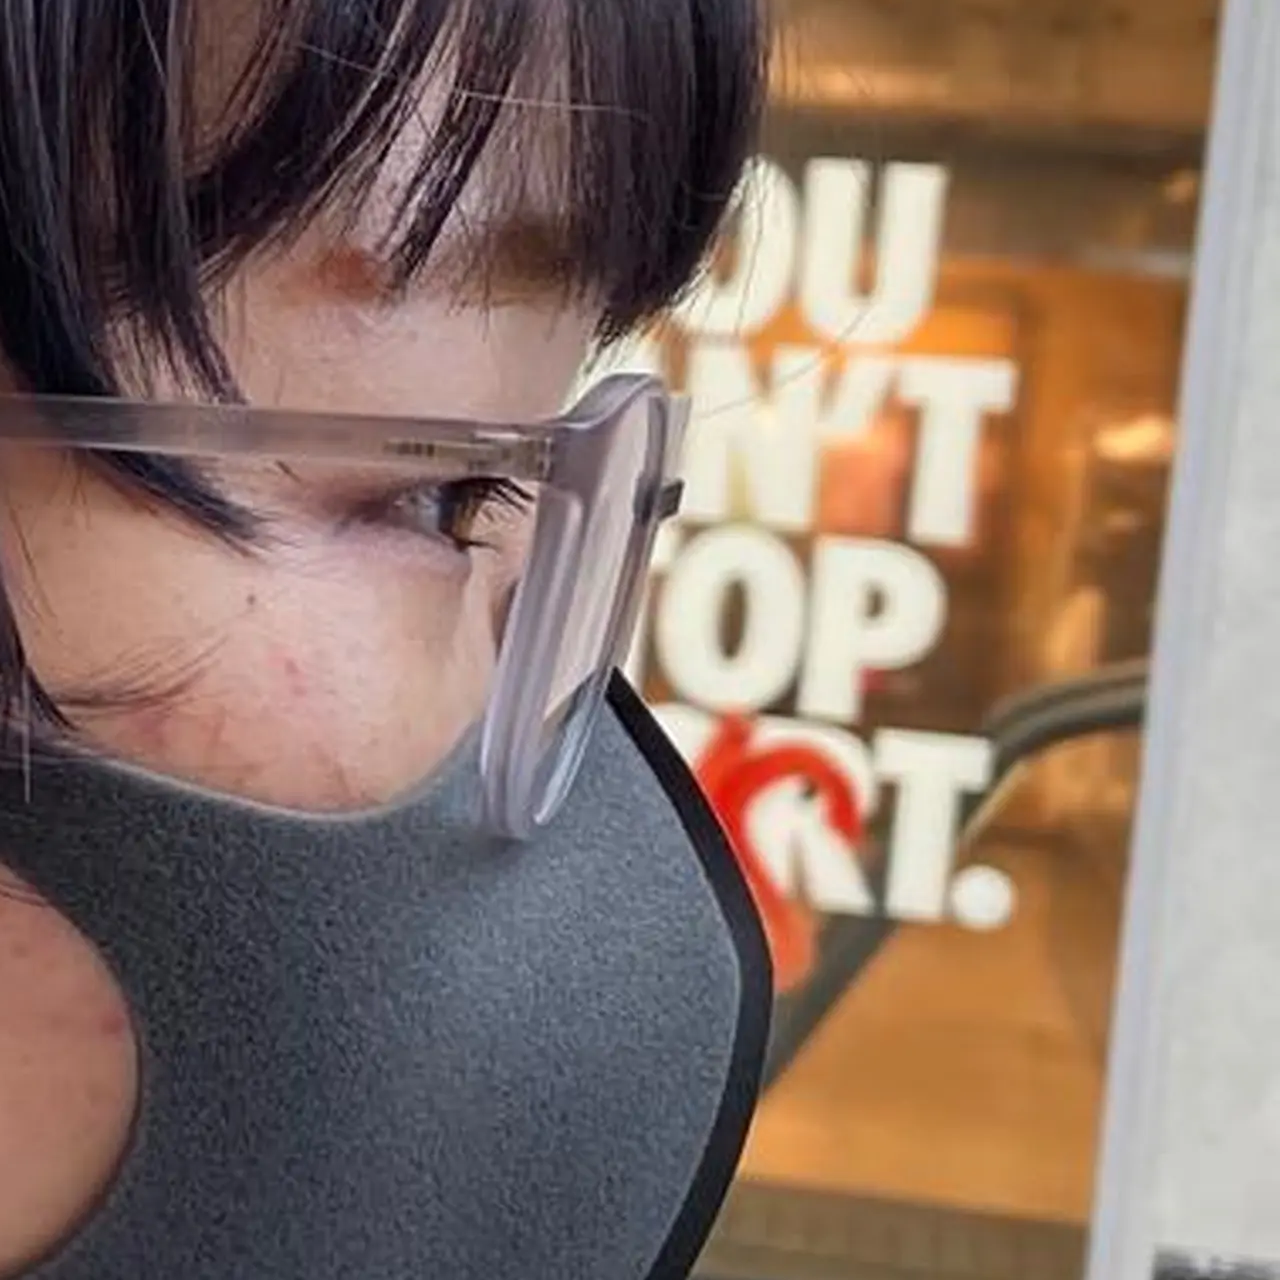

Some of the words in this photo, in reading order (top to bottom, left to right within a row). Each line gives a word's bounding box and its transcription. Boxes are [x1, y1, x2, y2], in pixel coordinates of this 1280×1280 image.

[670, 154, 949, 342] OU
[635, 335, 1018, 547] N'T
[651, 524, 949, 724] OP
